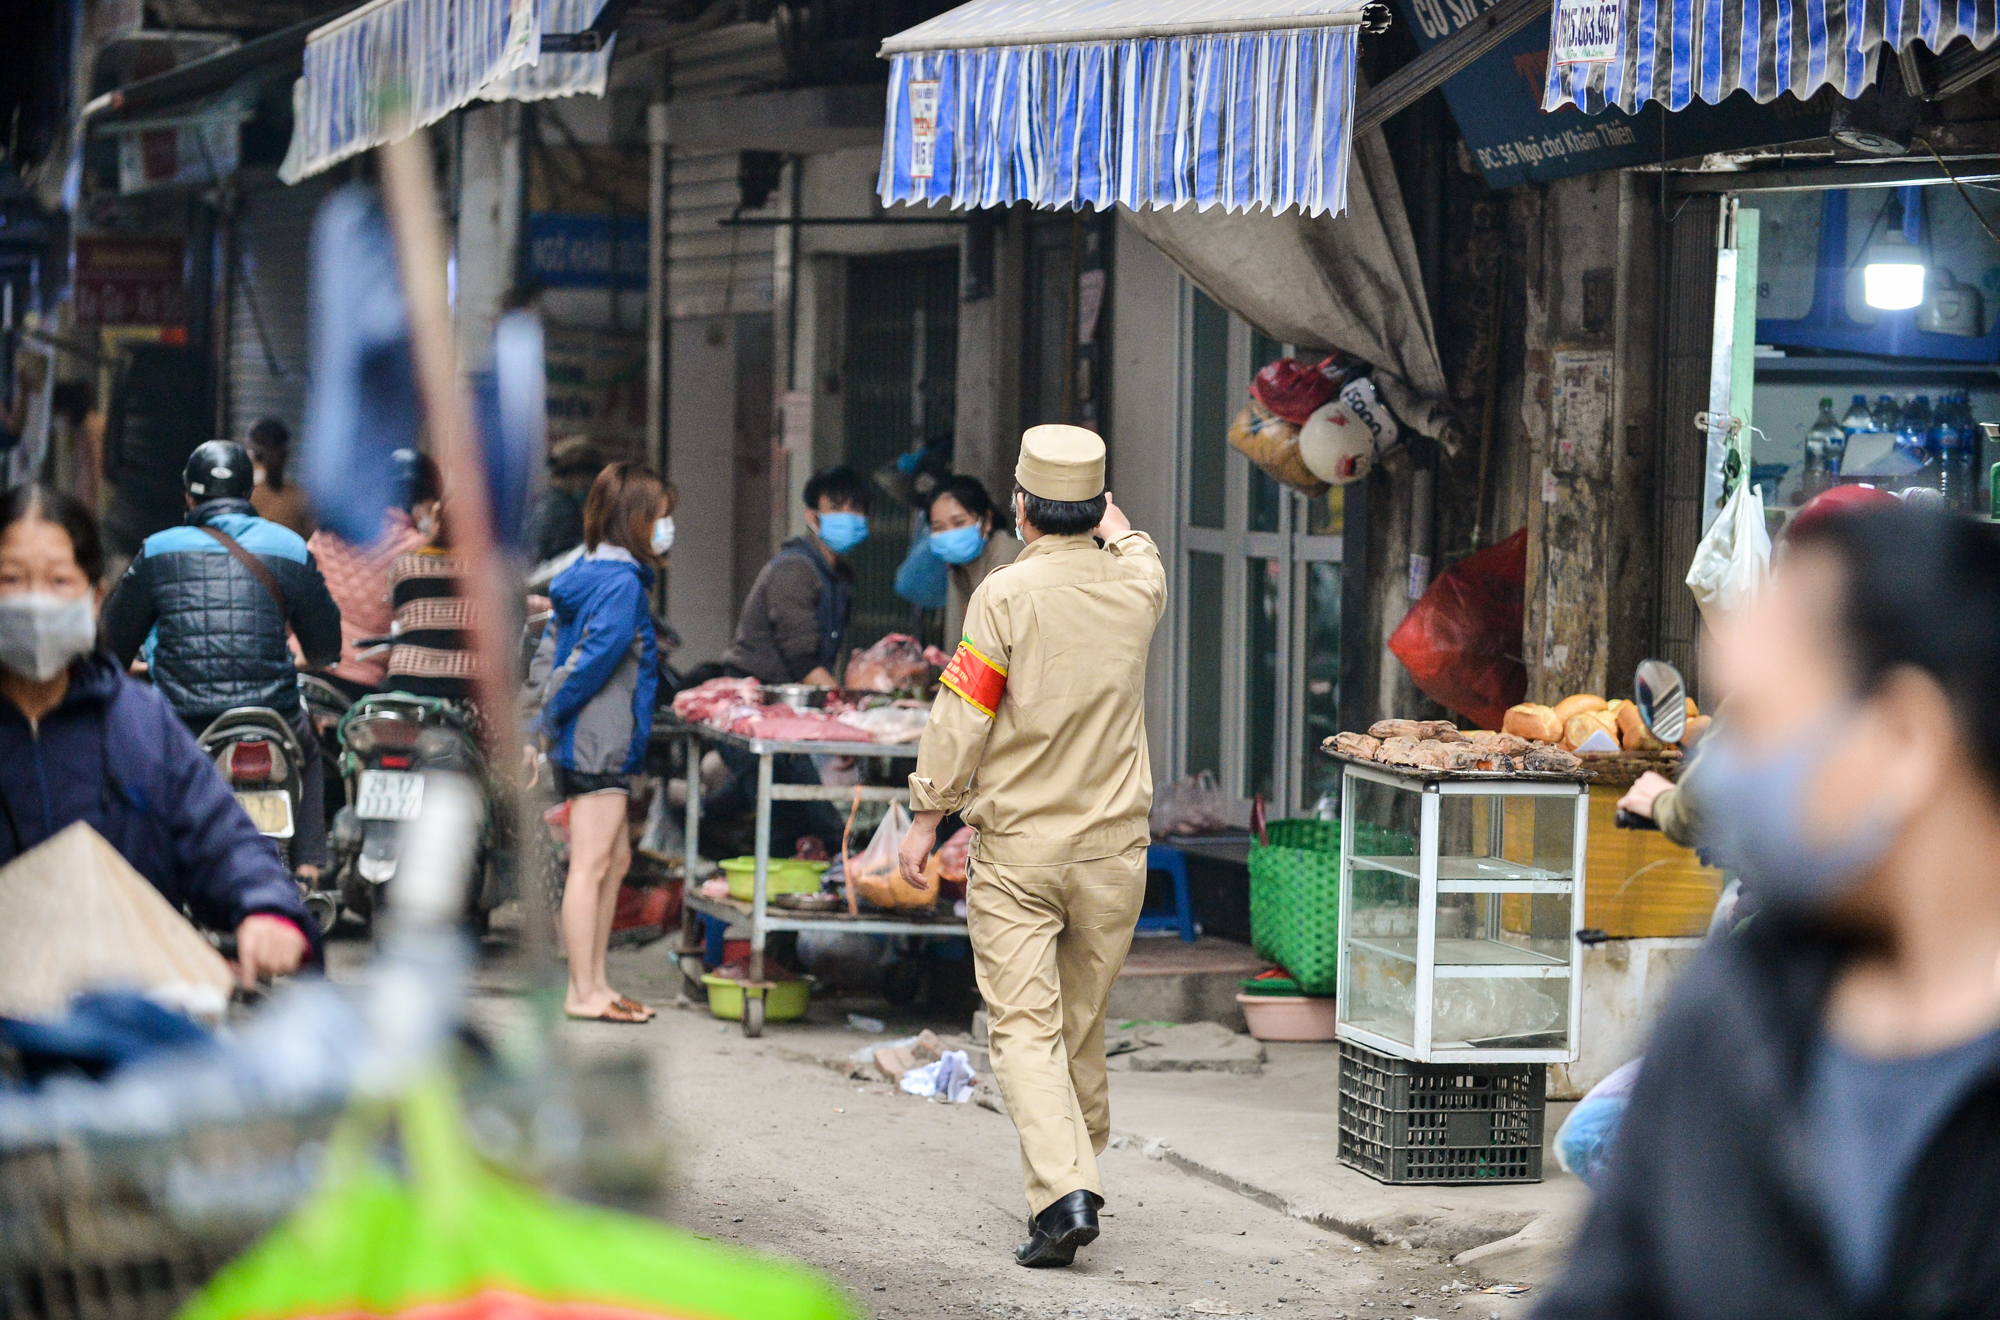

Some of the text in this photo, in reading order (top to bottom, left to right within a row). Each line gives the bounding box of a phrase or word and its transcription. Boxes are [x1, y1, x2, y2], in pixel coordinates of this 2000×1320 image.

[1497, 142, 1519, 166] 56
[1513, 135, 1543, 166] Ngõ
[1541, 134, 1569, 163] chợ
[1562, 125, 1600, 153] Khâm
[1596, 119, 1636, 146] Thiên
